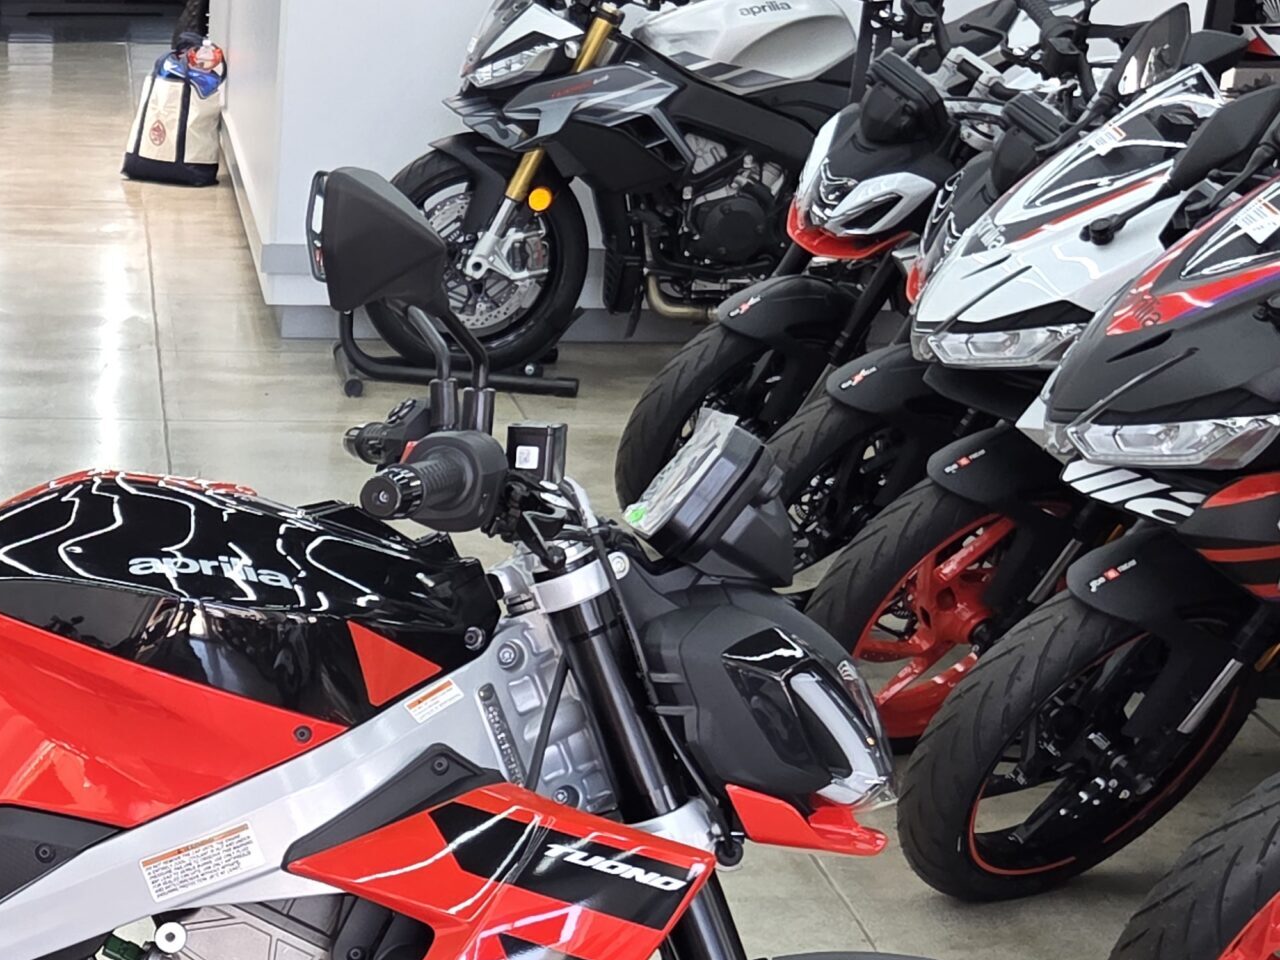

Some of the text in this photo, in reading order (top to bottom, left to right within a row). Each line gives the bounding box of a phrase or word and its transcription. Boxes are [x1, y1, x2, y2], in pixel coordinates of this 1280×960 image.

[739, 0, 792, 16] aprilia
[128, 555, 293, 589] aprilia
[544, 843, 687, 891] TUONO
